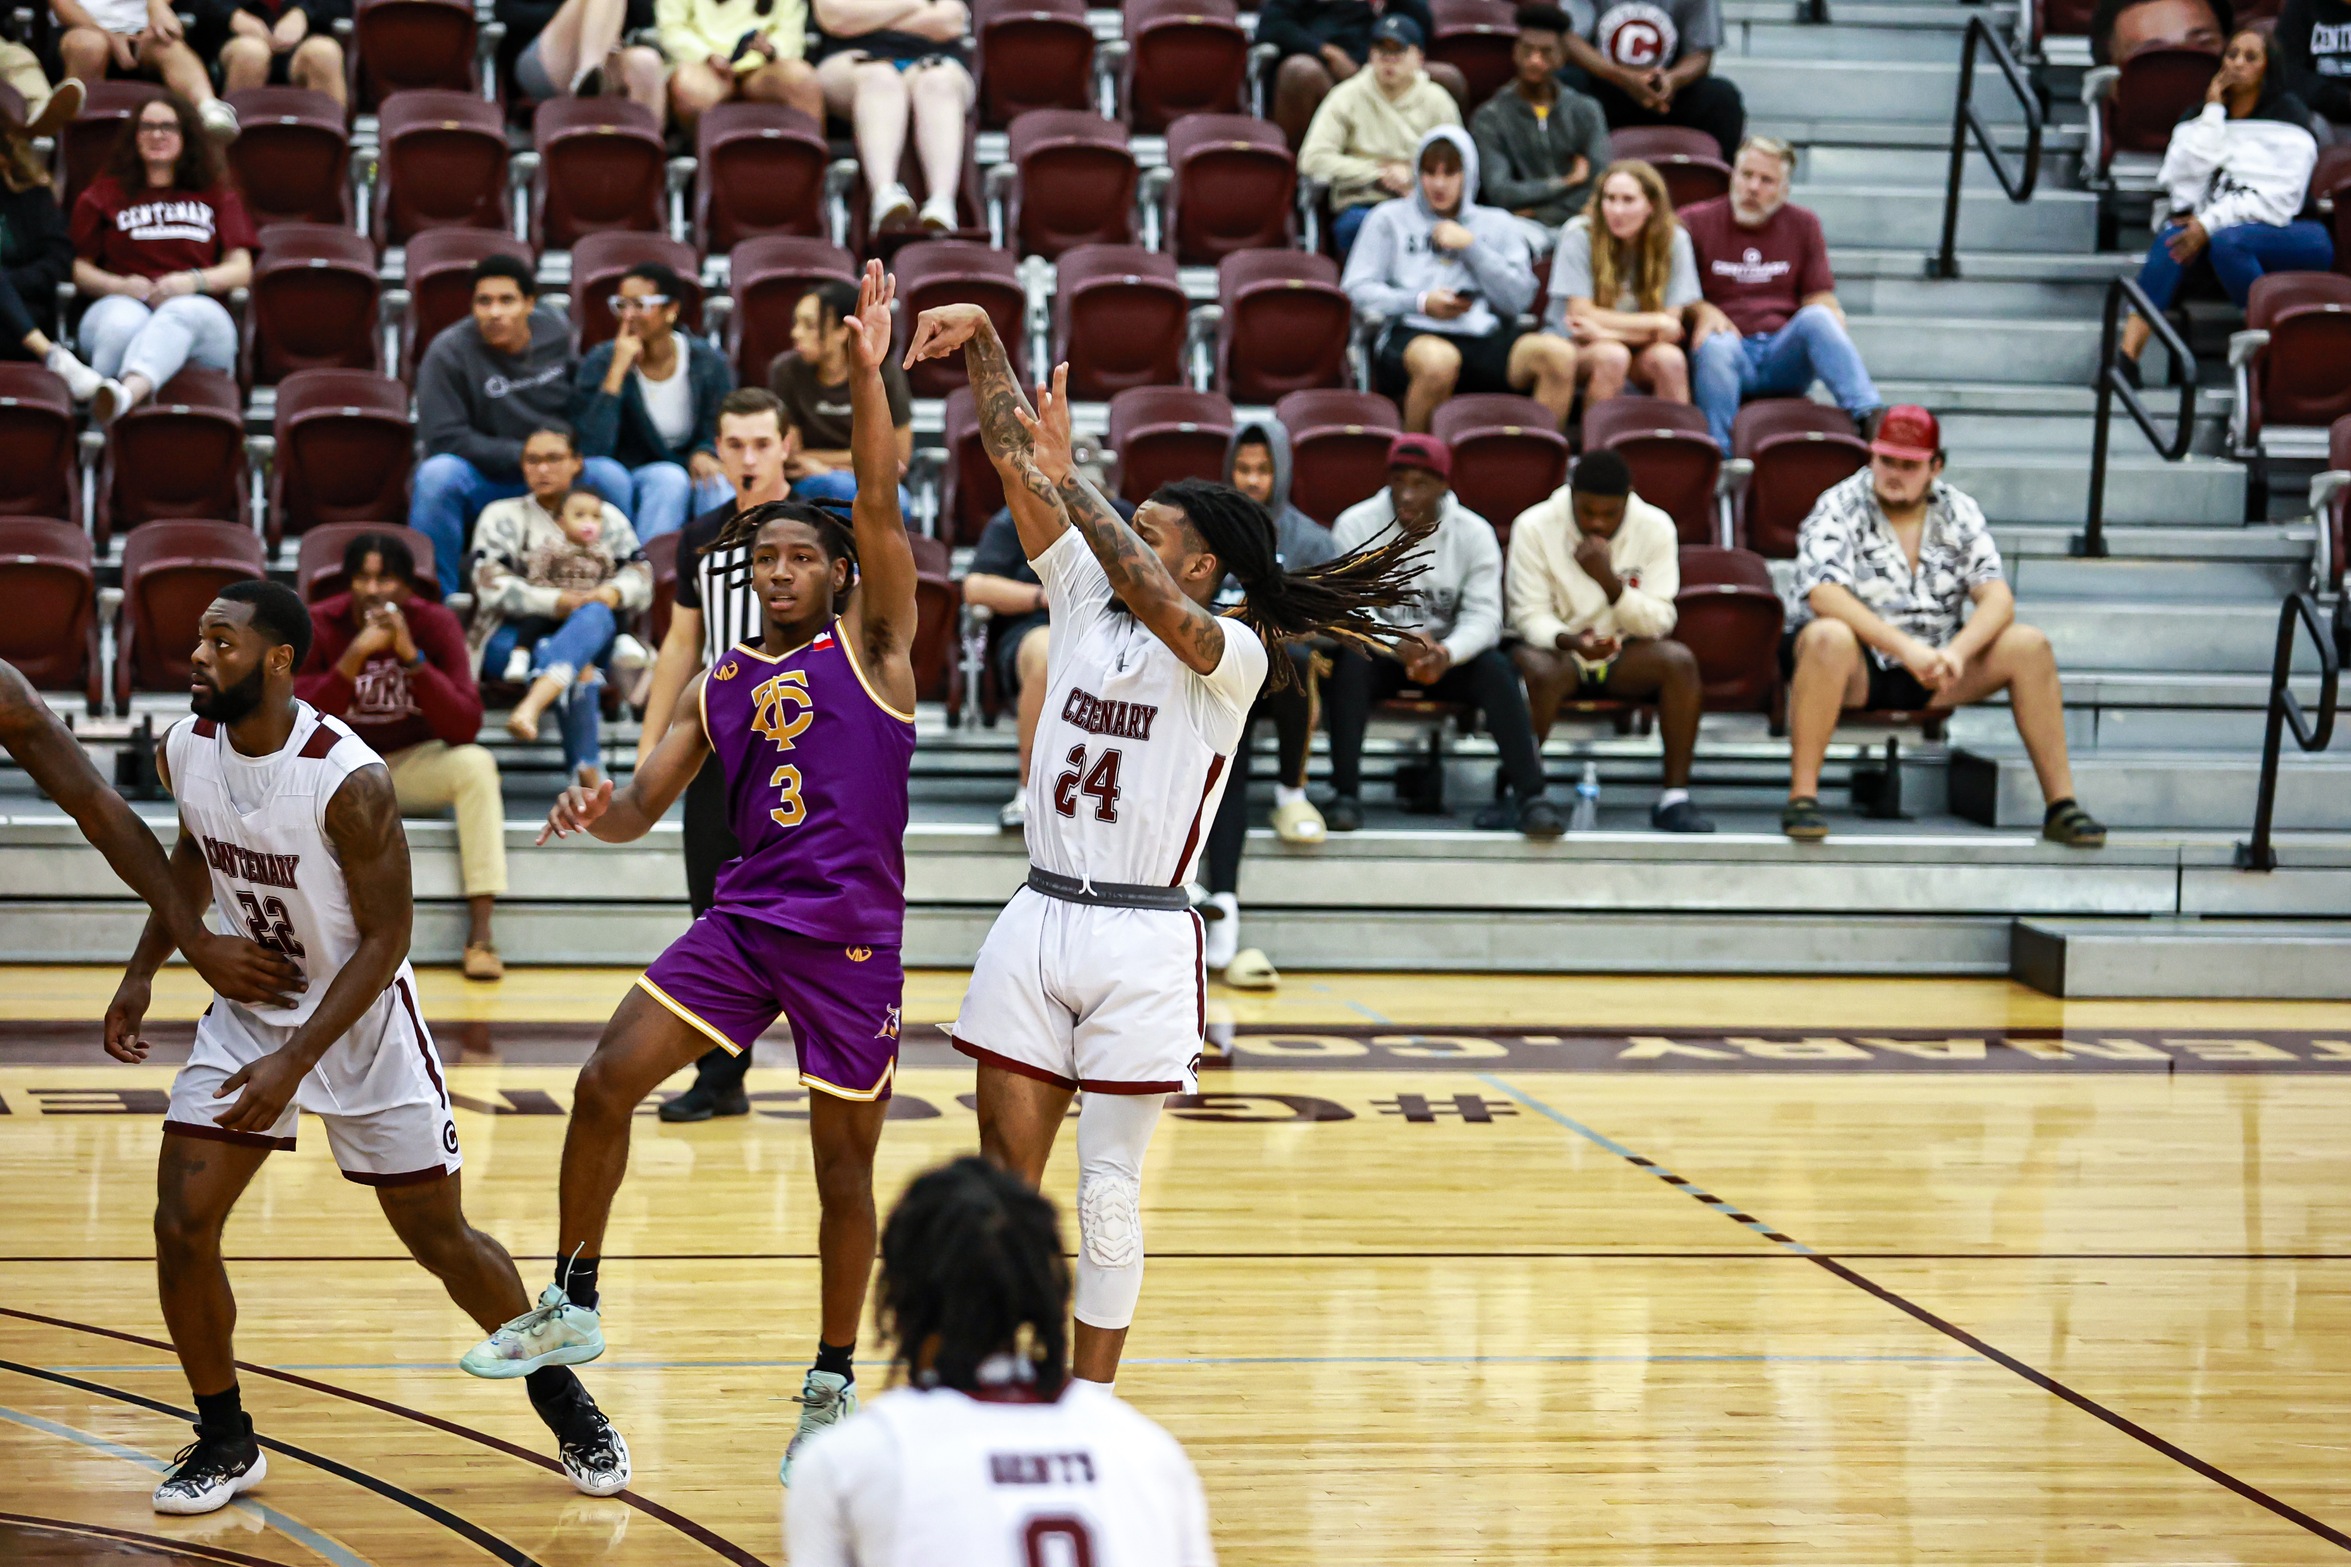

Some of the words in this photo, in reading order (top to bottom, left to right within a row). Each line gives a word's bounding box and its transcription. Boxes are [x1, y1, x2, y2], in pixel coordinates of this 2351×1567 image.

[2310, 22, 2351, 55] CENT
[1061, 686, 1158, 741] CEENARY
[769, 763, 807, 828] 3
[1054, 743, 1122, 824] 24
[236, 890, 306, 959] 22
